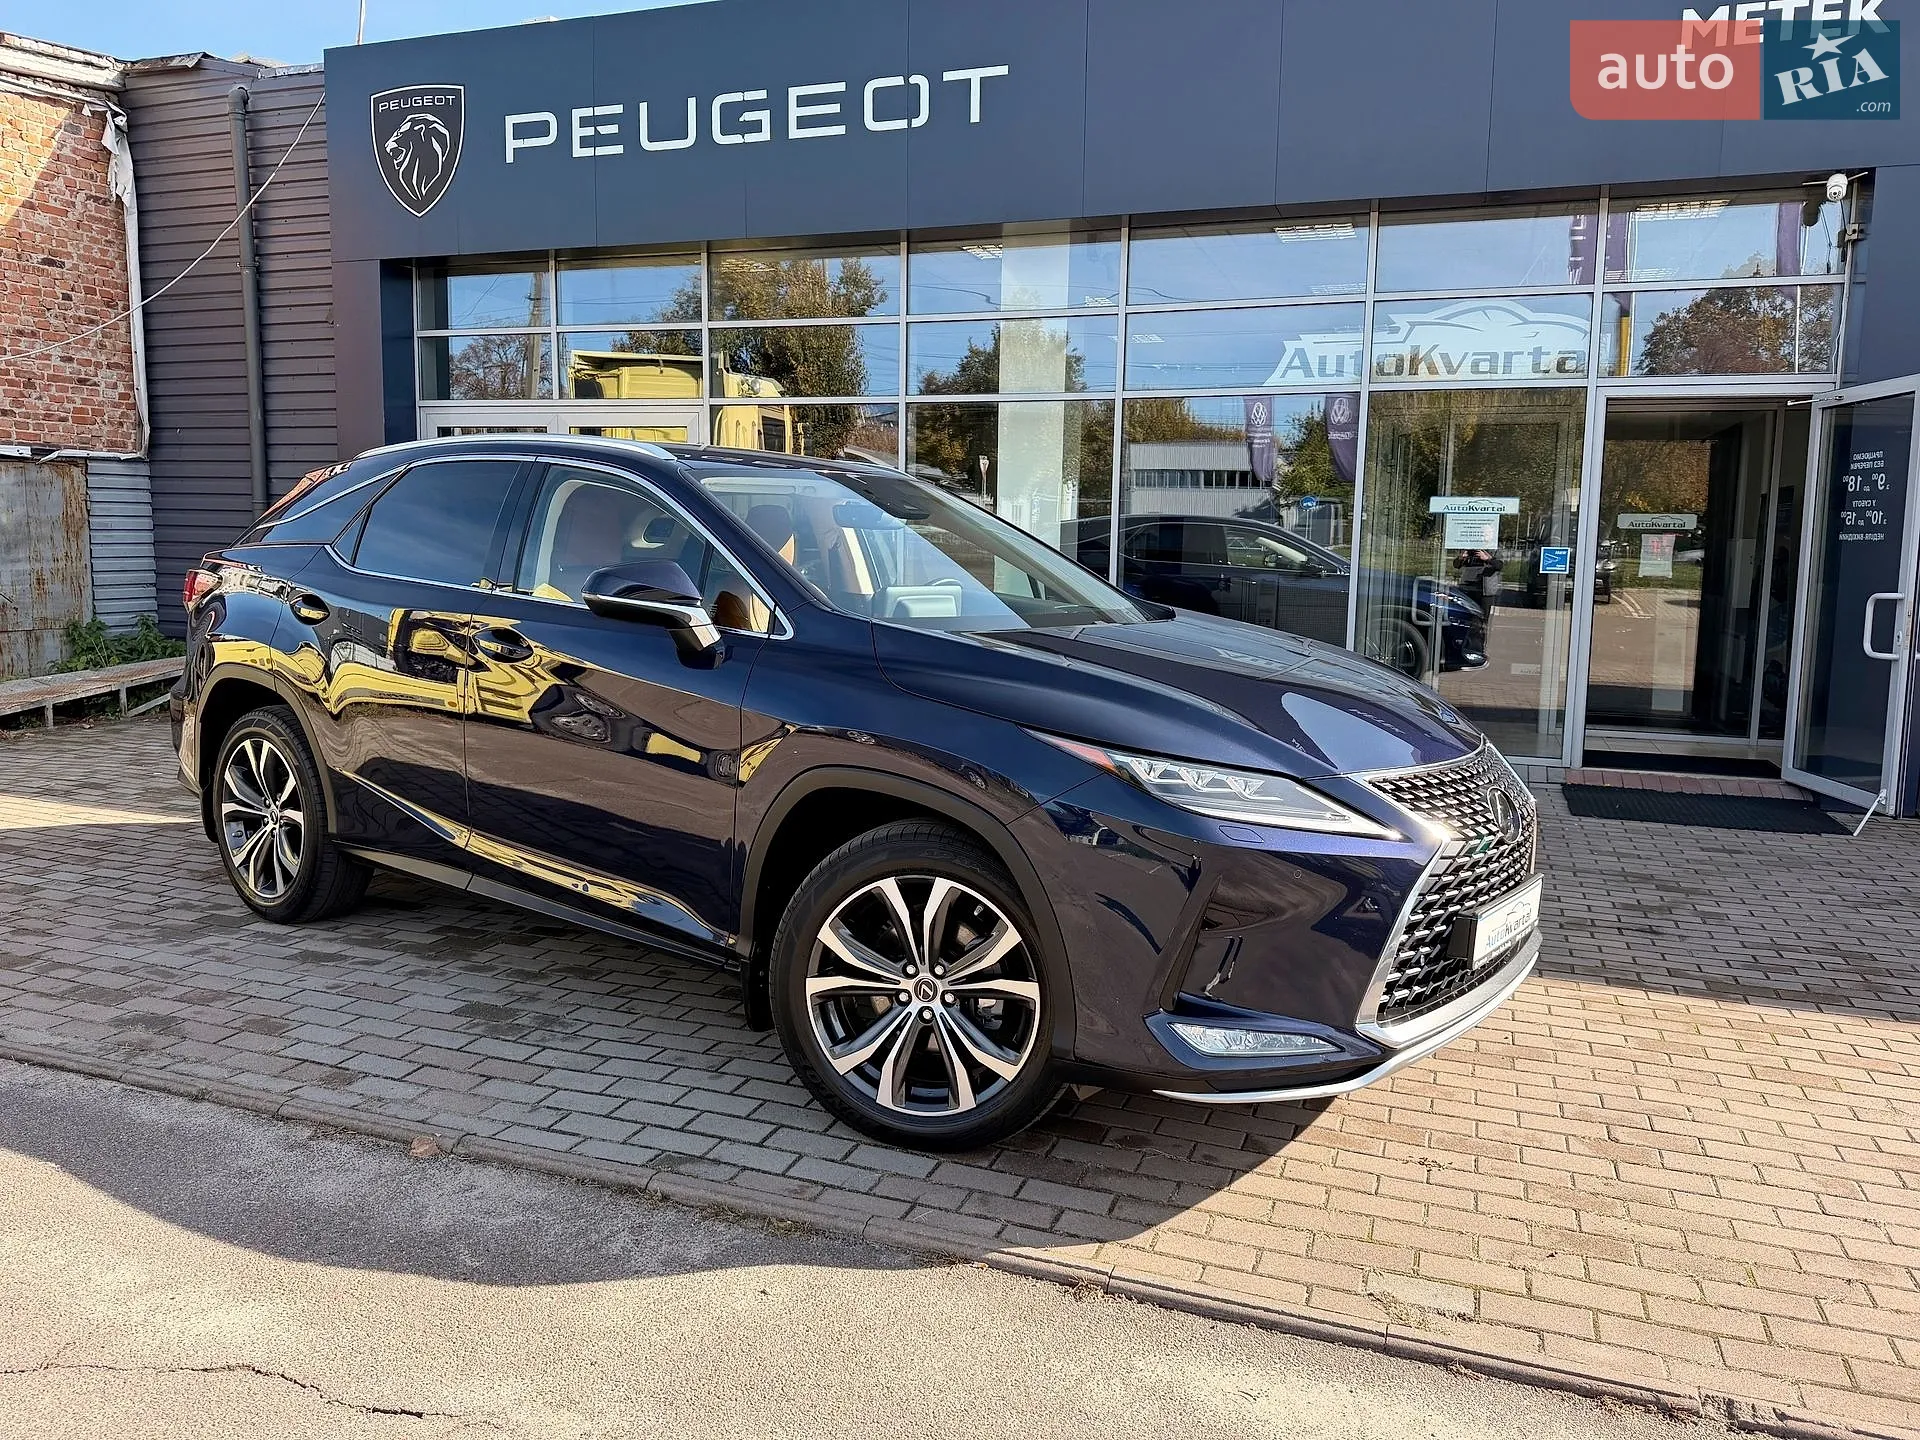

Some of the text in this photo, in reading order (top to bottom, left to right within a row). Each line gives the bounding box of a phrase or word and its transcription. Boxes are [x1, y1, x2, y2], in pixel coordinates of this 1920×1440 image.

[378, 95, 456, 113] PEUGEOT
[504, 64, 1009, 164] PEUGEOT
[1280, 343, 1589, 379] AutoKvarta
[1442, 504, 1506, 512] AutoKvartal
[1628, 521, 1687, 529] AutoKvartal
